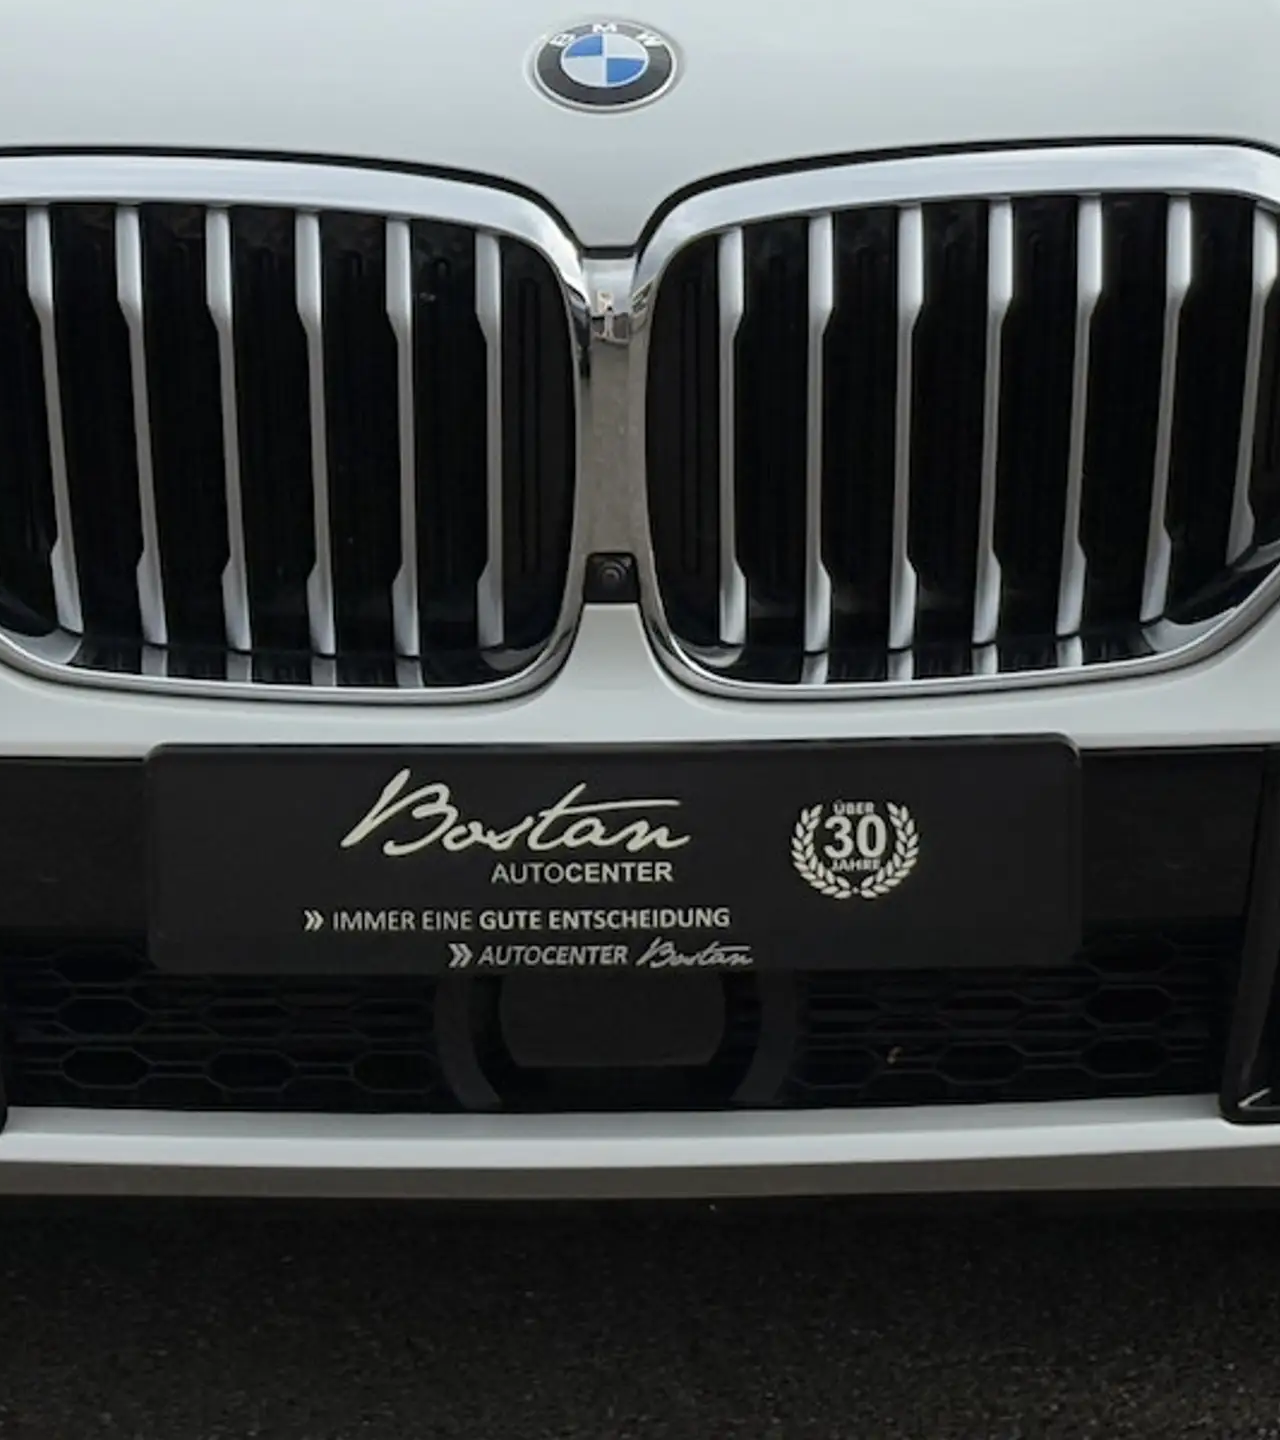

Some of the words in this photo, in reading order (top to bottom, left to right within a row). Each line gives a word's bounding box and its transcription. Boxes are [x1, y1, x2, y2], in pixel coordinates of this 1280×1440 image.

[549, 22, 666, 47] BMW
[340, 768, 691, 856] Bostan
[833, 799, 875, 814] ÜBER
[823, 814, 888, 859] 30
[491, 861, 674, 884] AUTOCENTER
[832, 859, 880, 872] JAHRE
[333, 910, 416, 931] IMMER
[422, 910, 472, 931] EINE
[479, 909, 542, 931] GUTE
[548, 907, 731, 930] ENTSCHEIDUNG
[477, 943, 628, 966] AUTOCENTER
[635, 936, 754, 969] Bostan
